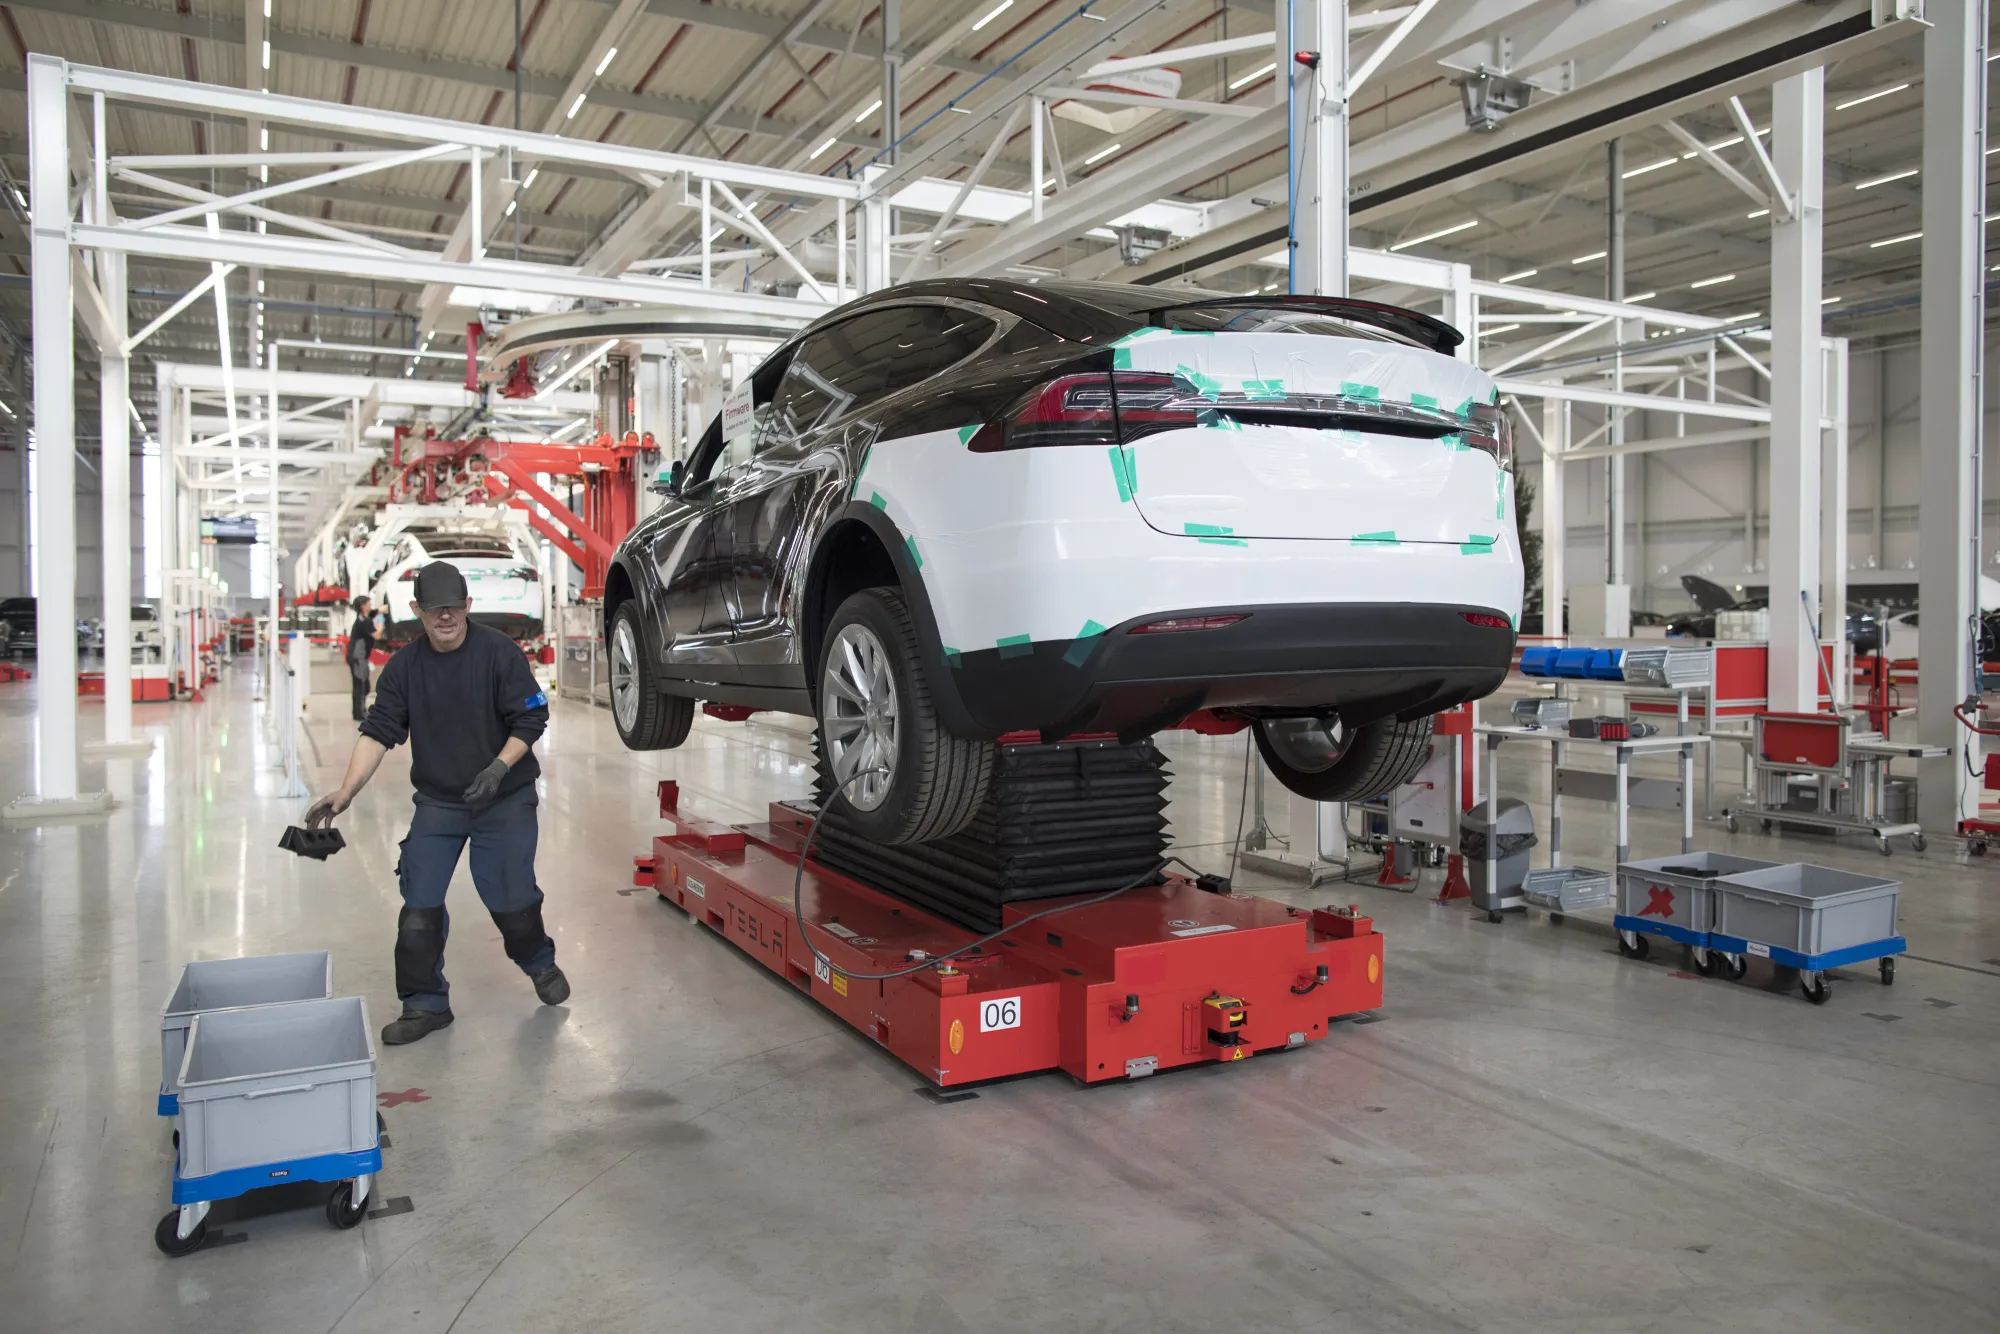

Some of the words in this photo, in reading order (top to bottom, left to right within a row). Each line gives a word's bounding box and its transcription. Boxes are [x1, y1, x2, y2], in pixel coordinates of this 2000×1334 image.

[725, 402, 750, 420] Firmware
[1314, 398, 1404, 416] TESLA
[727, 900, 783, 959] TESLA
[985, 1001, 1016, 1028] 06
